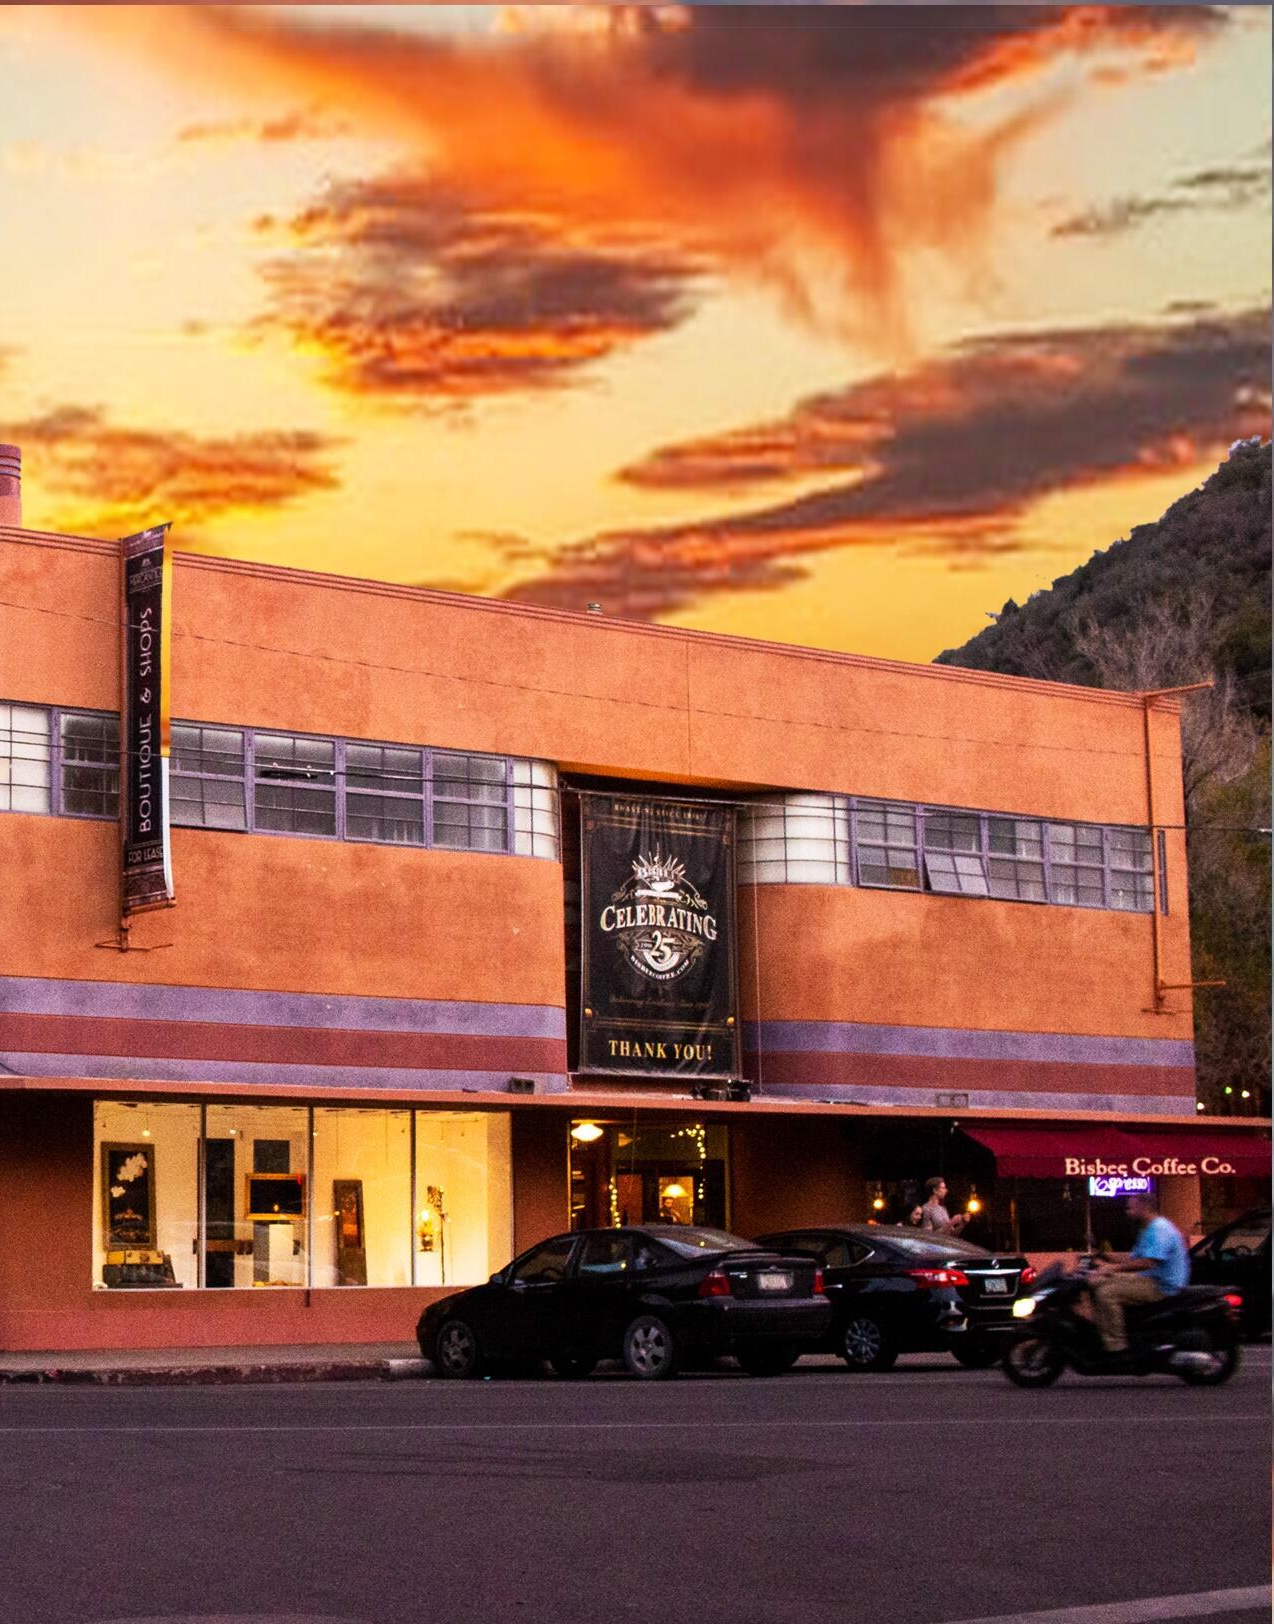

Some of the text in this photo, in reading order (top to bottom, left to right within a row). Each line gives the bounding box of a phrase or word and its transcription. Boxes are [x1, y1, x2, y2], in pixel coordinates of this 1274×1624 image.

[139, 608, 152, 833] BOUTIQUE & SHOPS
[128, 846, 164, 864] FOR LEASE
[600, 904, 717, 940] CELEBRATING
[650, 930, 675, 963] 25
[609, 1040, 712, 1060] THANK YOU!
[1064, 1156, 1237, 1175] Bisbee Coffee Co.
